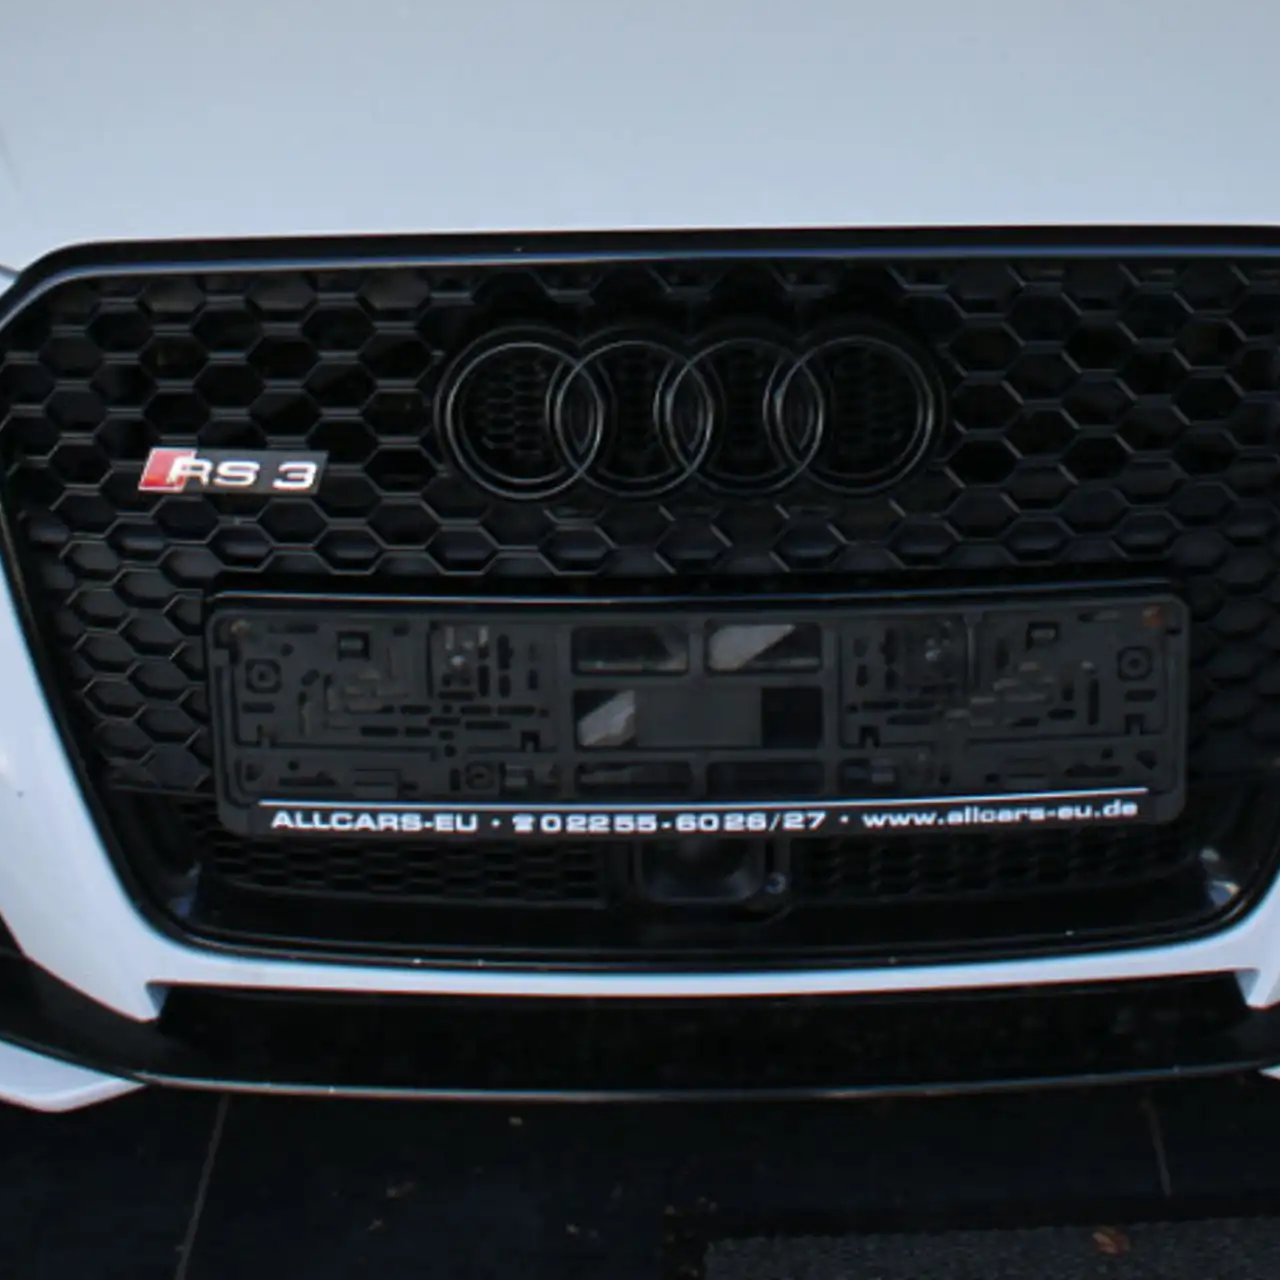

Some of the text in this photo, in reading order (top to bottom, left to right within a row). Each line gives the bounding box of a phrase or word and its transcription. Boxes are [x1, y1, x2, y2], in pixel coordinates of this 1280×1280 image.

[166, 455, 318, 491] RS 3
[270, 809, 479, 833] ALLCARS-EU
[862, 798, 1139, 829] www.allcars-eu.de
